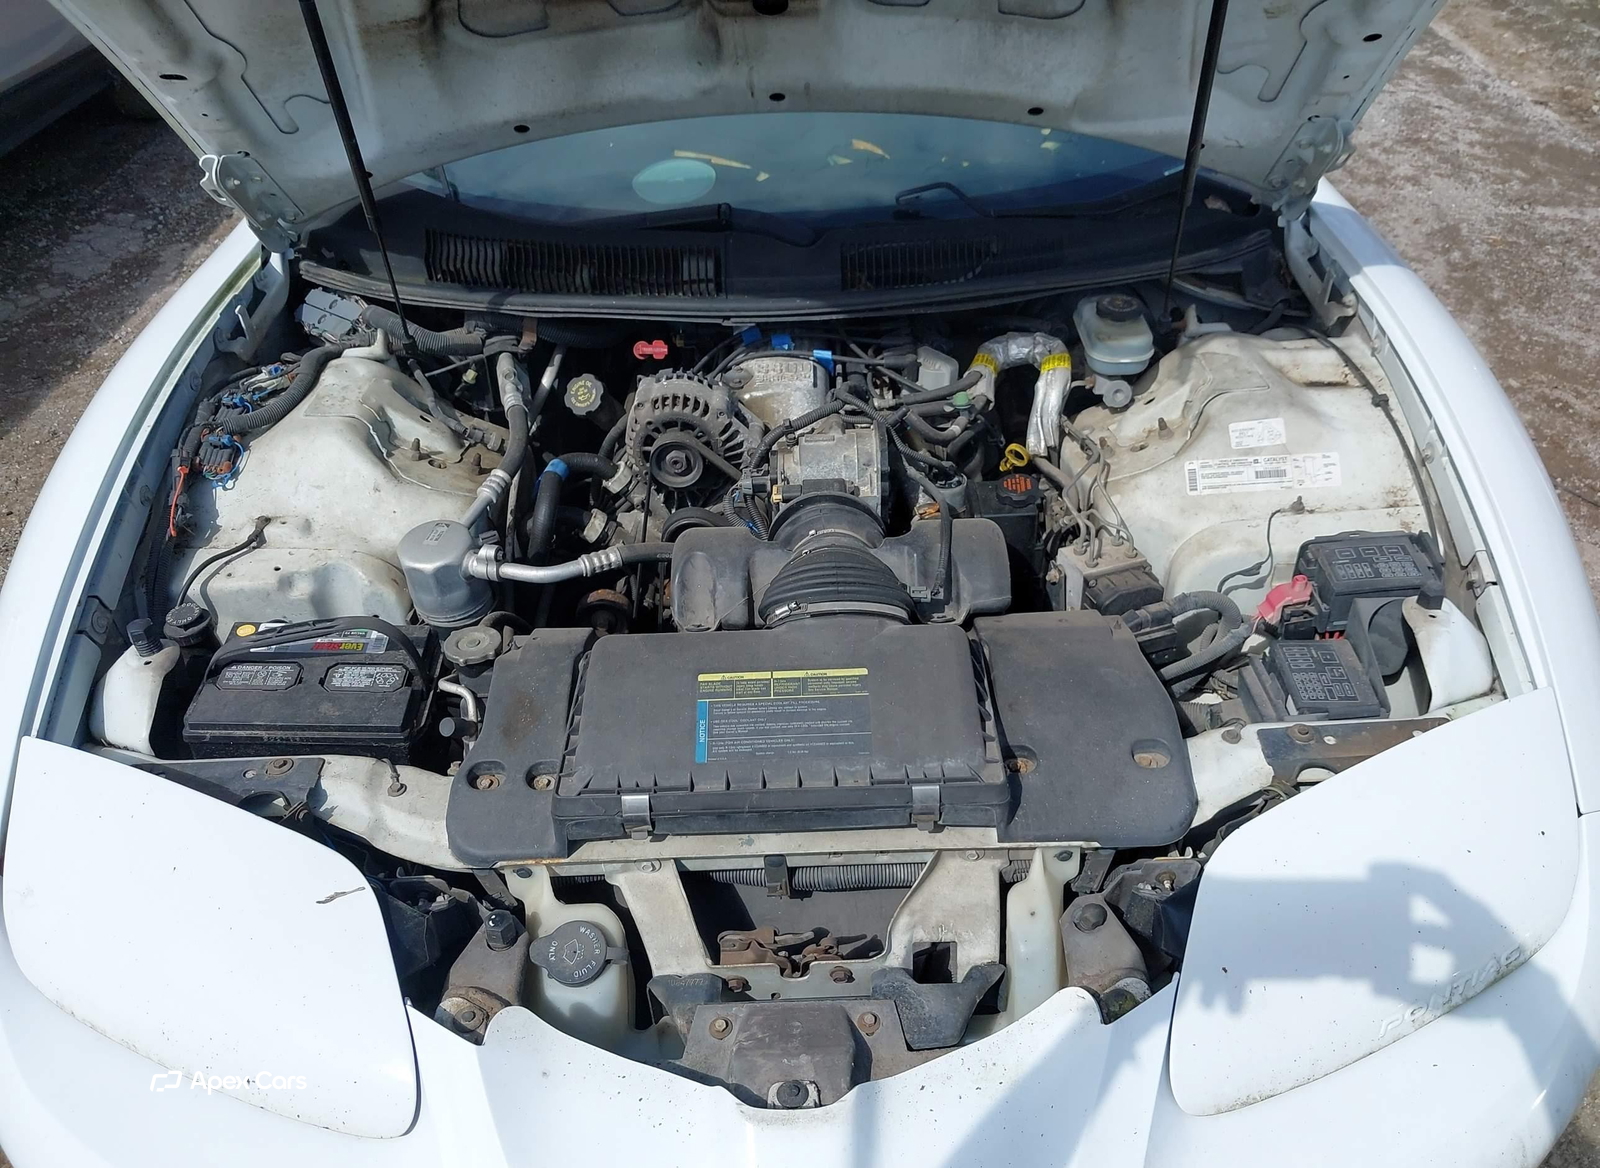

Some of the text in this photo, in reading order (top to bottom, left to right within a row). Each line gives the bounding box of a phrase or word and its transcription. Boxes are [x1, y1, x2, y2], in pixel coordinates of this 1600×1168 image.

[549, 926, 600, 978] WASHER FLUID ONLY
